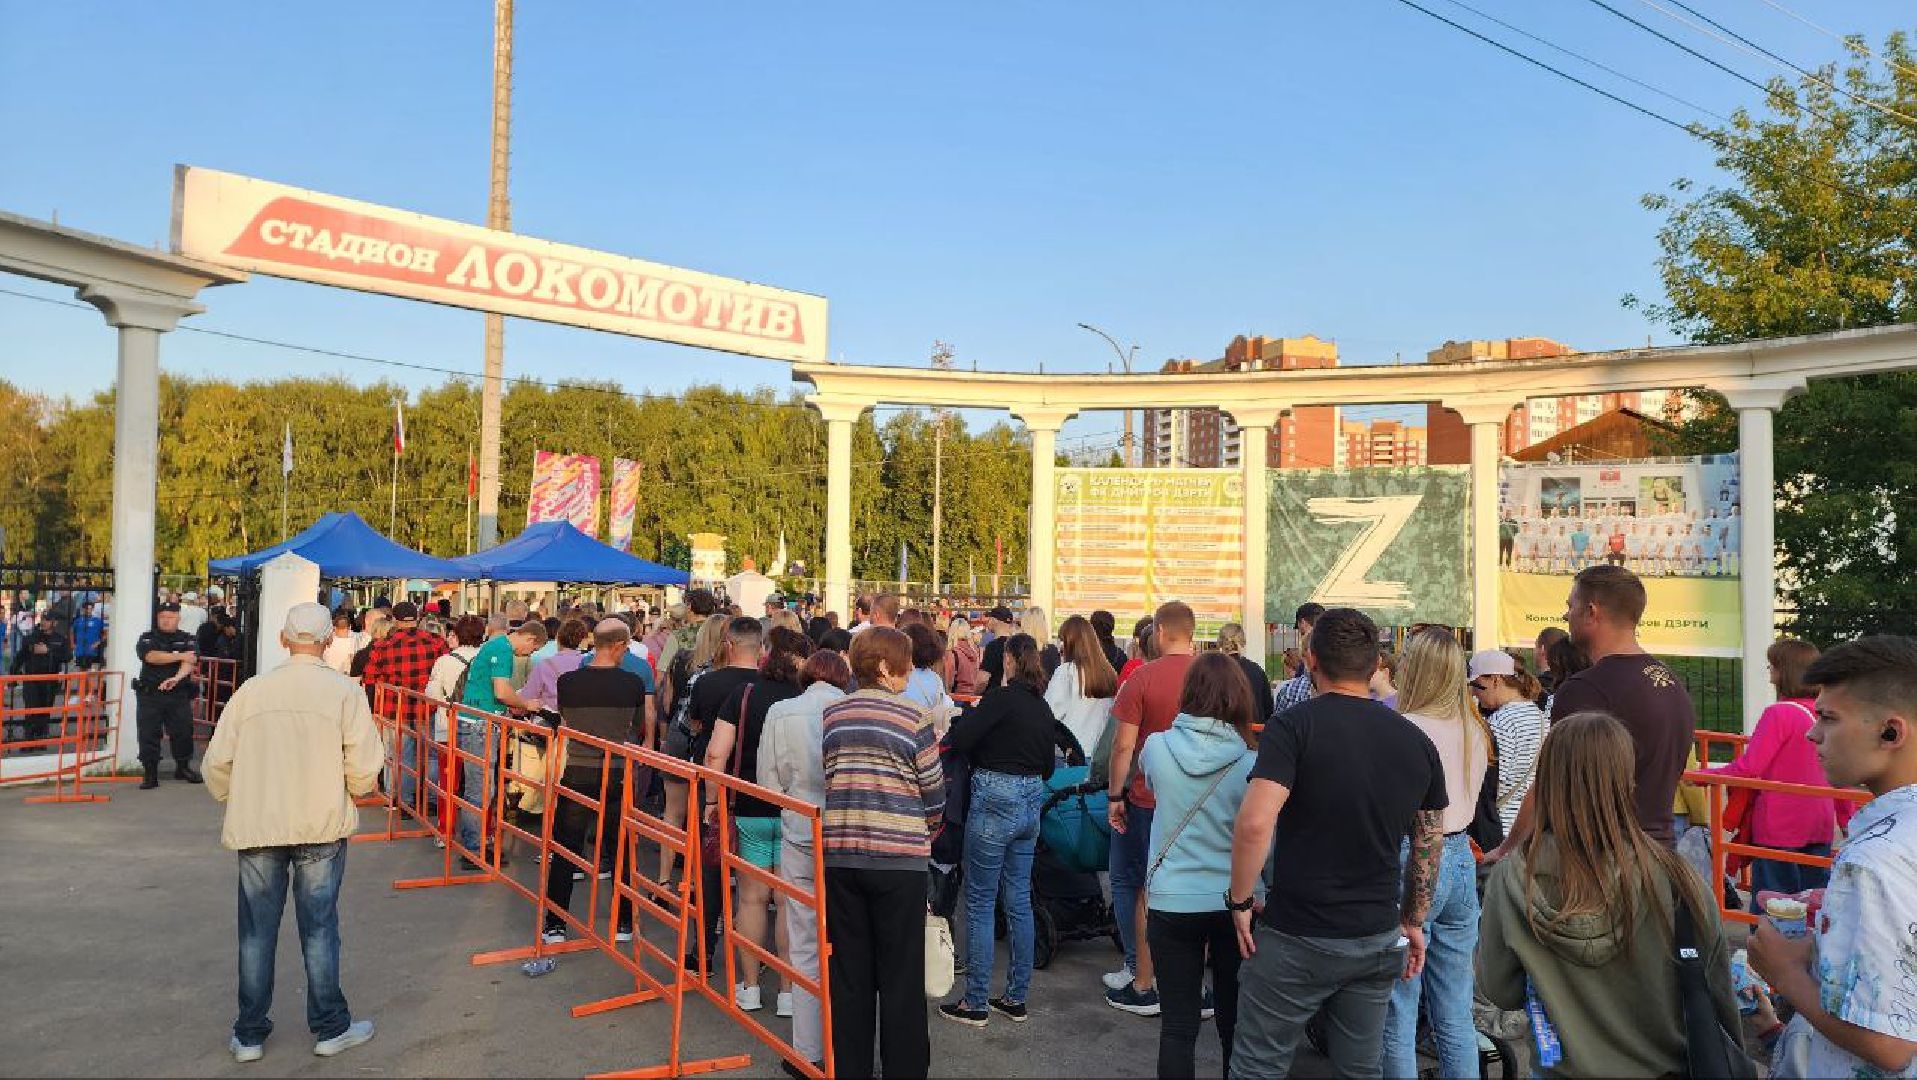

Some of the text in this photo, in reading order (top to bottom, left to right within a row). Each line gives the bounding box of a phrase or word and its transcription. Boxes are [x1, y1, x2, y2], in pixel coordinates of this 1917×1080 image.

[259, 218, 796, 338] СТАДИОН ЛОКОМОТИВ
[1306, 494, 1424, 609] Z
[1664, 619, 1709, 629] ДЗРТИ
